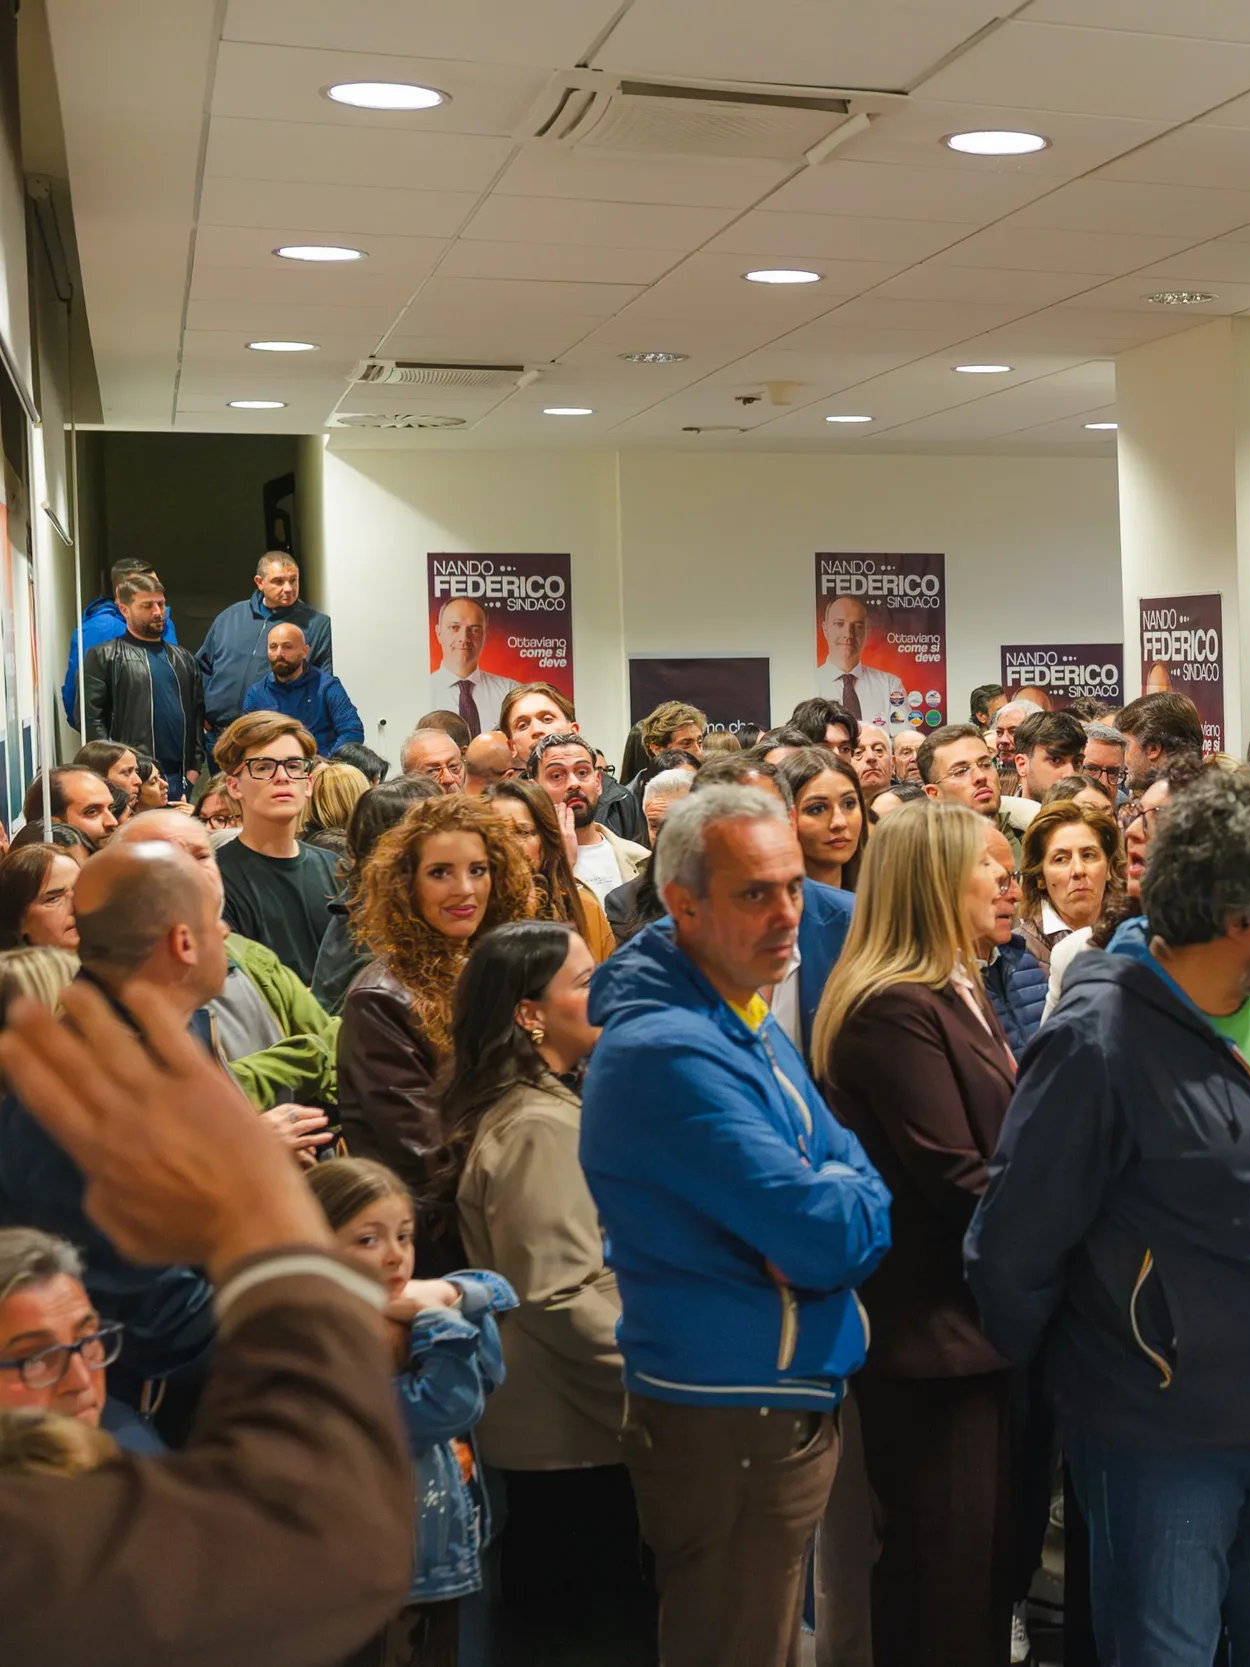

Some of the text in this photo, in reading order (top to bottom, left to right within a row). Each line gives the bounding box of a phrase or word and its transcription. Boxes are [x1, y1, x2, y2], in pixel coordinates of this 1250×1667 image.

[434, 560, 494, 576] NANDO
[821, 560, 876, 575] NANDO
[434, 575, 565, 598] FEDERICO
[821, 575, 940, 596] FEDERICO
[507, 598, 566, 612] SINDACO
[886, 596, 940, 609] SINDACO
[1142, 608, 1177, 630] NANDO
[507, 636, 567, 648] Ottaviano
[886, 633, 941, 644] Ottaviano
[1143, 629, 1219, 662] FEDERICO
[519, 646, 566, 658] come si
[897, 643, 940, 654] come si
[538, 657, 567, 668] deve
[914, 653, 941, 663] deve
[1006, 652, 1058, 666] NANDO
[1006, 664, 1119, 686] FEDERICO
[1182, 663, 1220, 682] SINDACO
[1068, 685, 1119, 698] SINDACO
[728, 719, 755, 734] ch
[1200, 721, 1221, 737] viano
